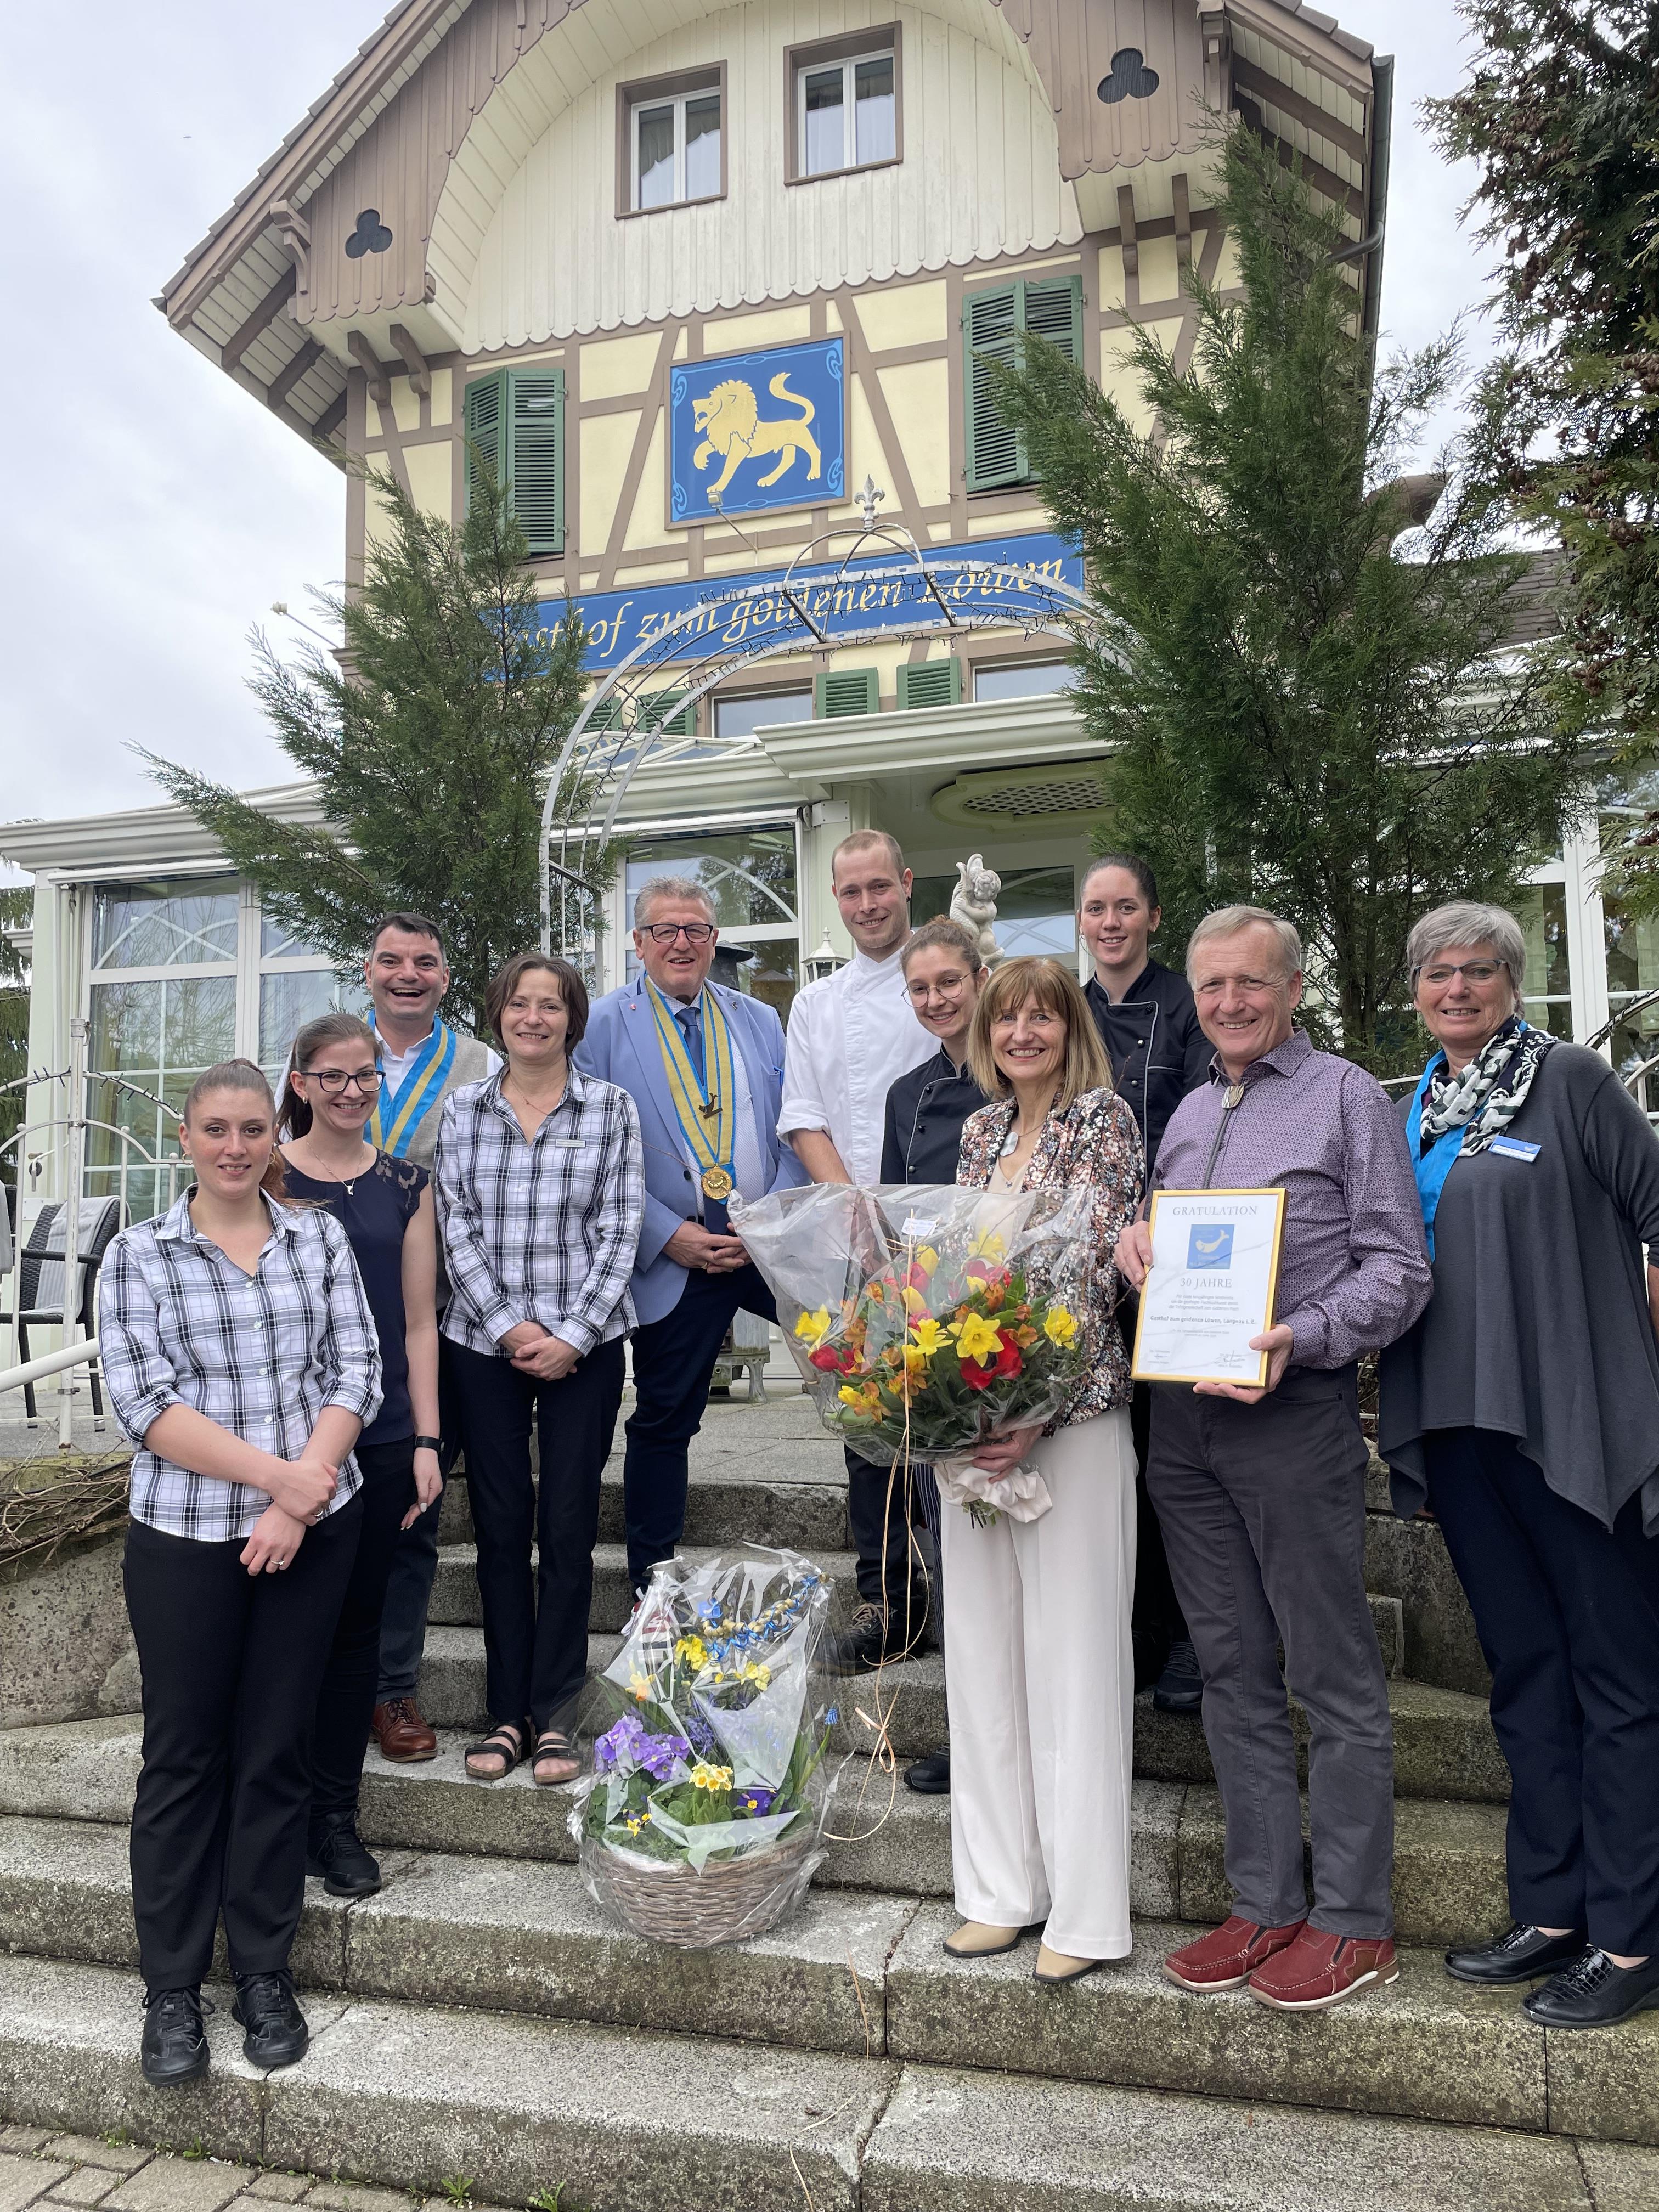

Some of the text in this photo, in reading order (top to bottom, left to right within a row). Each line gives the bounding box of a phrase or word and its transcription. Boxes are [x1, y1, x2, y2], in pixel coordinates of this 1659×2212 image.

[721, 579, 907, 643] goldenen
[1172, 1206, 1258, 1216] GRATULATION
[1180, 1278, 1232, 1290] 30 JAHRE
